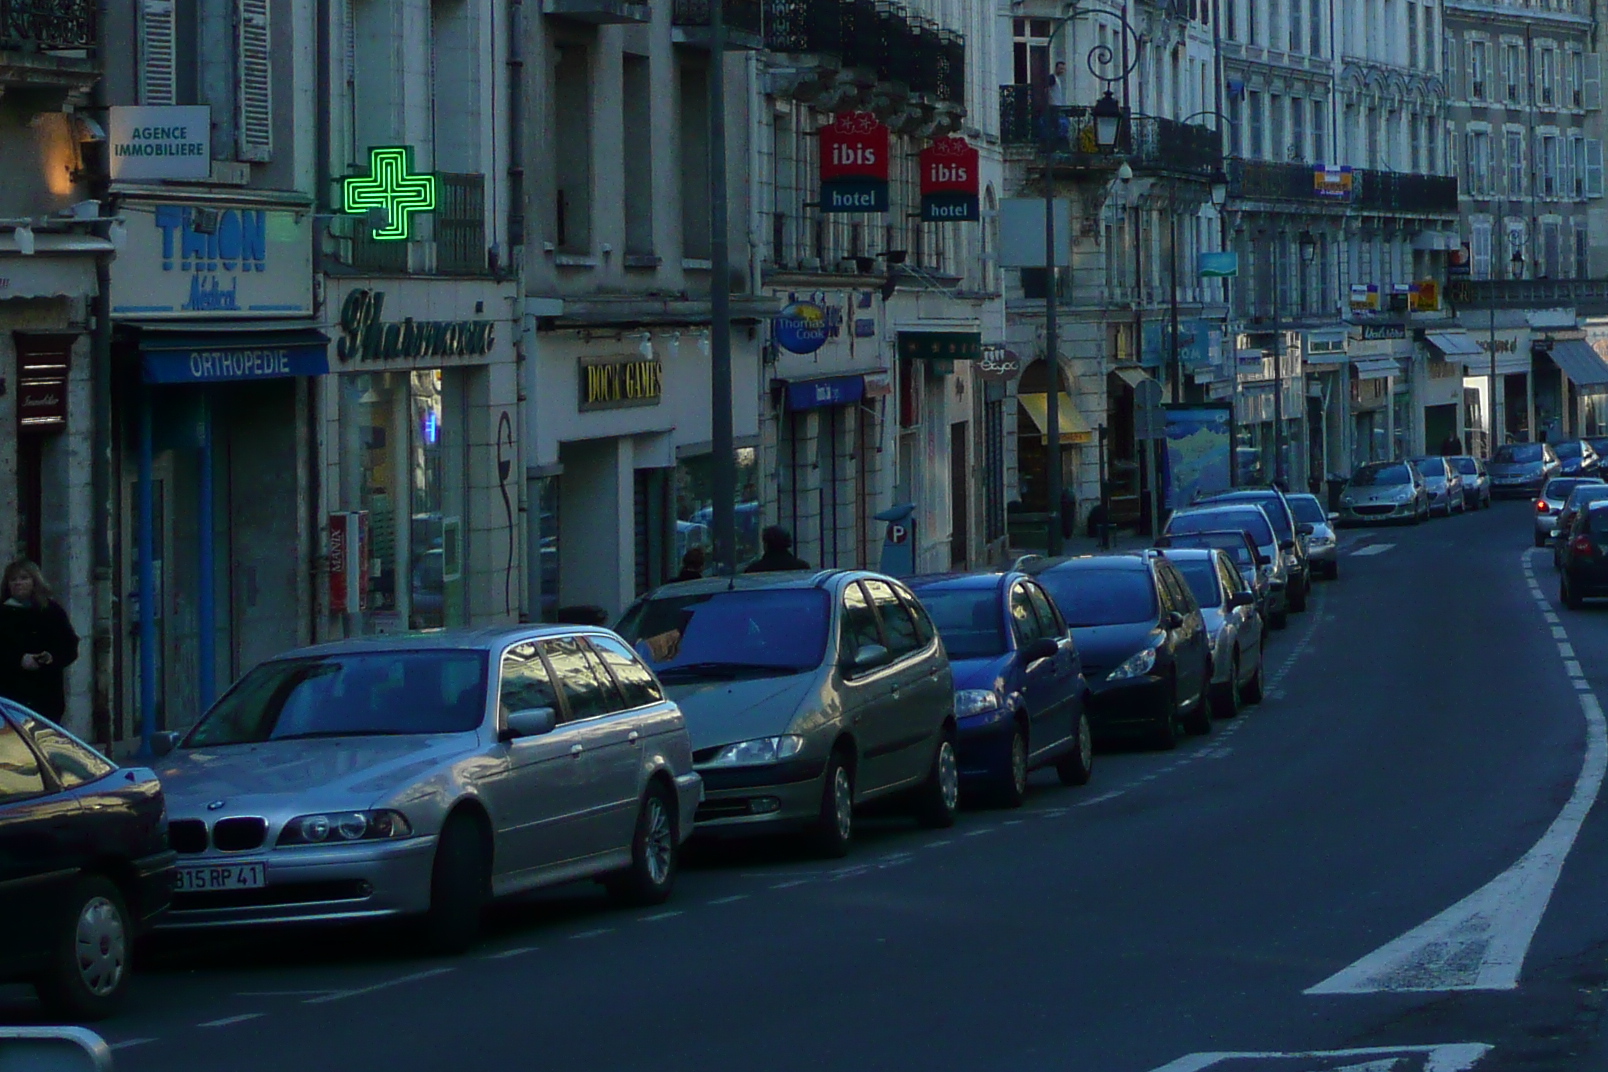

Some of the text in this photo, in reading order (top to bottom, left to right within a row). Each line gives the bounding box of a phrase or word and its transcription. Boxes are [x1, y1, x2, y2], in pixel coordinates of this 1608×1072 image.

[132, 126, 187, 140] AGENCE
[115, 143, 204, 156] IMMOBILIERE
[832, 142, 876, 165] ibis
[930, 162, 968, 182] ibis
[832, 190, 876, 206] hotel
[930, 203, 968, 216] hotel
[779, 317, 826, 330] Thomas
[796, 328, 825, 340] Cook
[190, 349, 290, 378] ORTHOPEDIE
[588, 360, 663, 403] DOCK GAMES
[893, 525, 904, 543] P
[331, 528, 342, 573] MANIX
[210, 868, 232, 887] RP
[236, 866, 258, 885] 41
